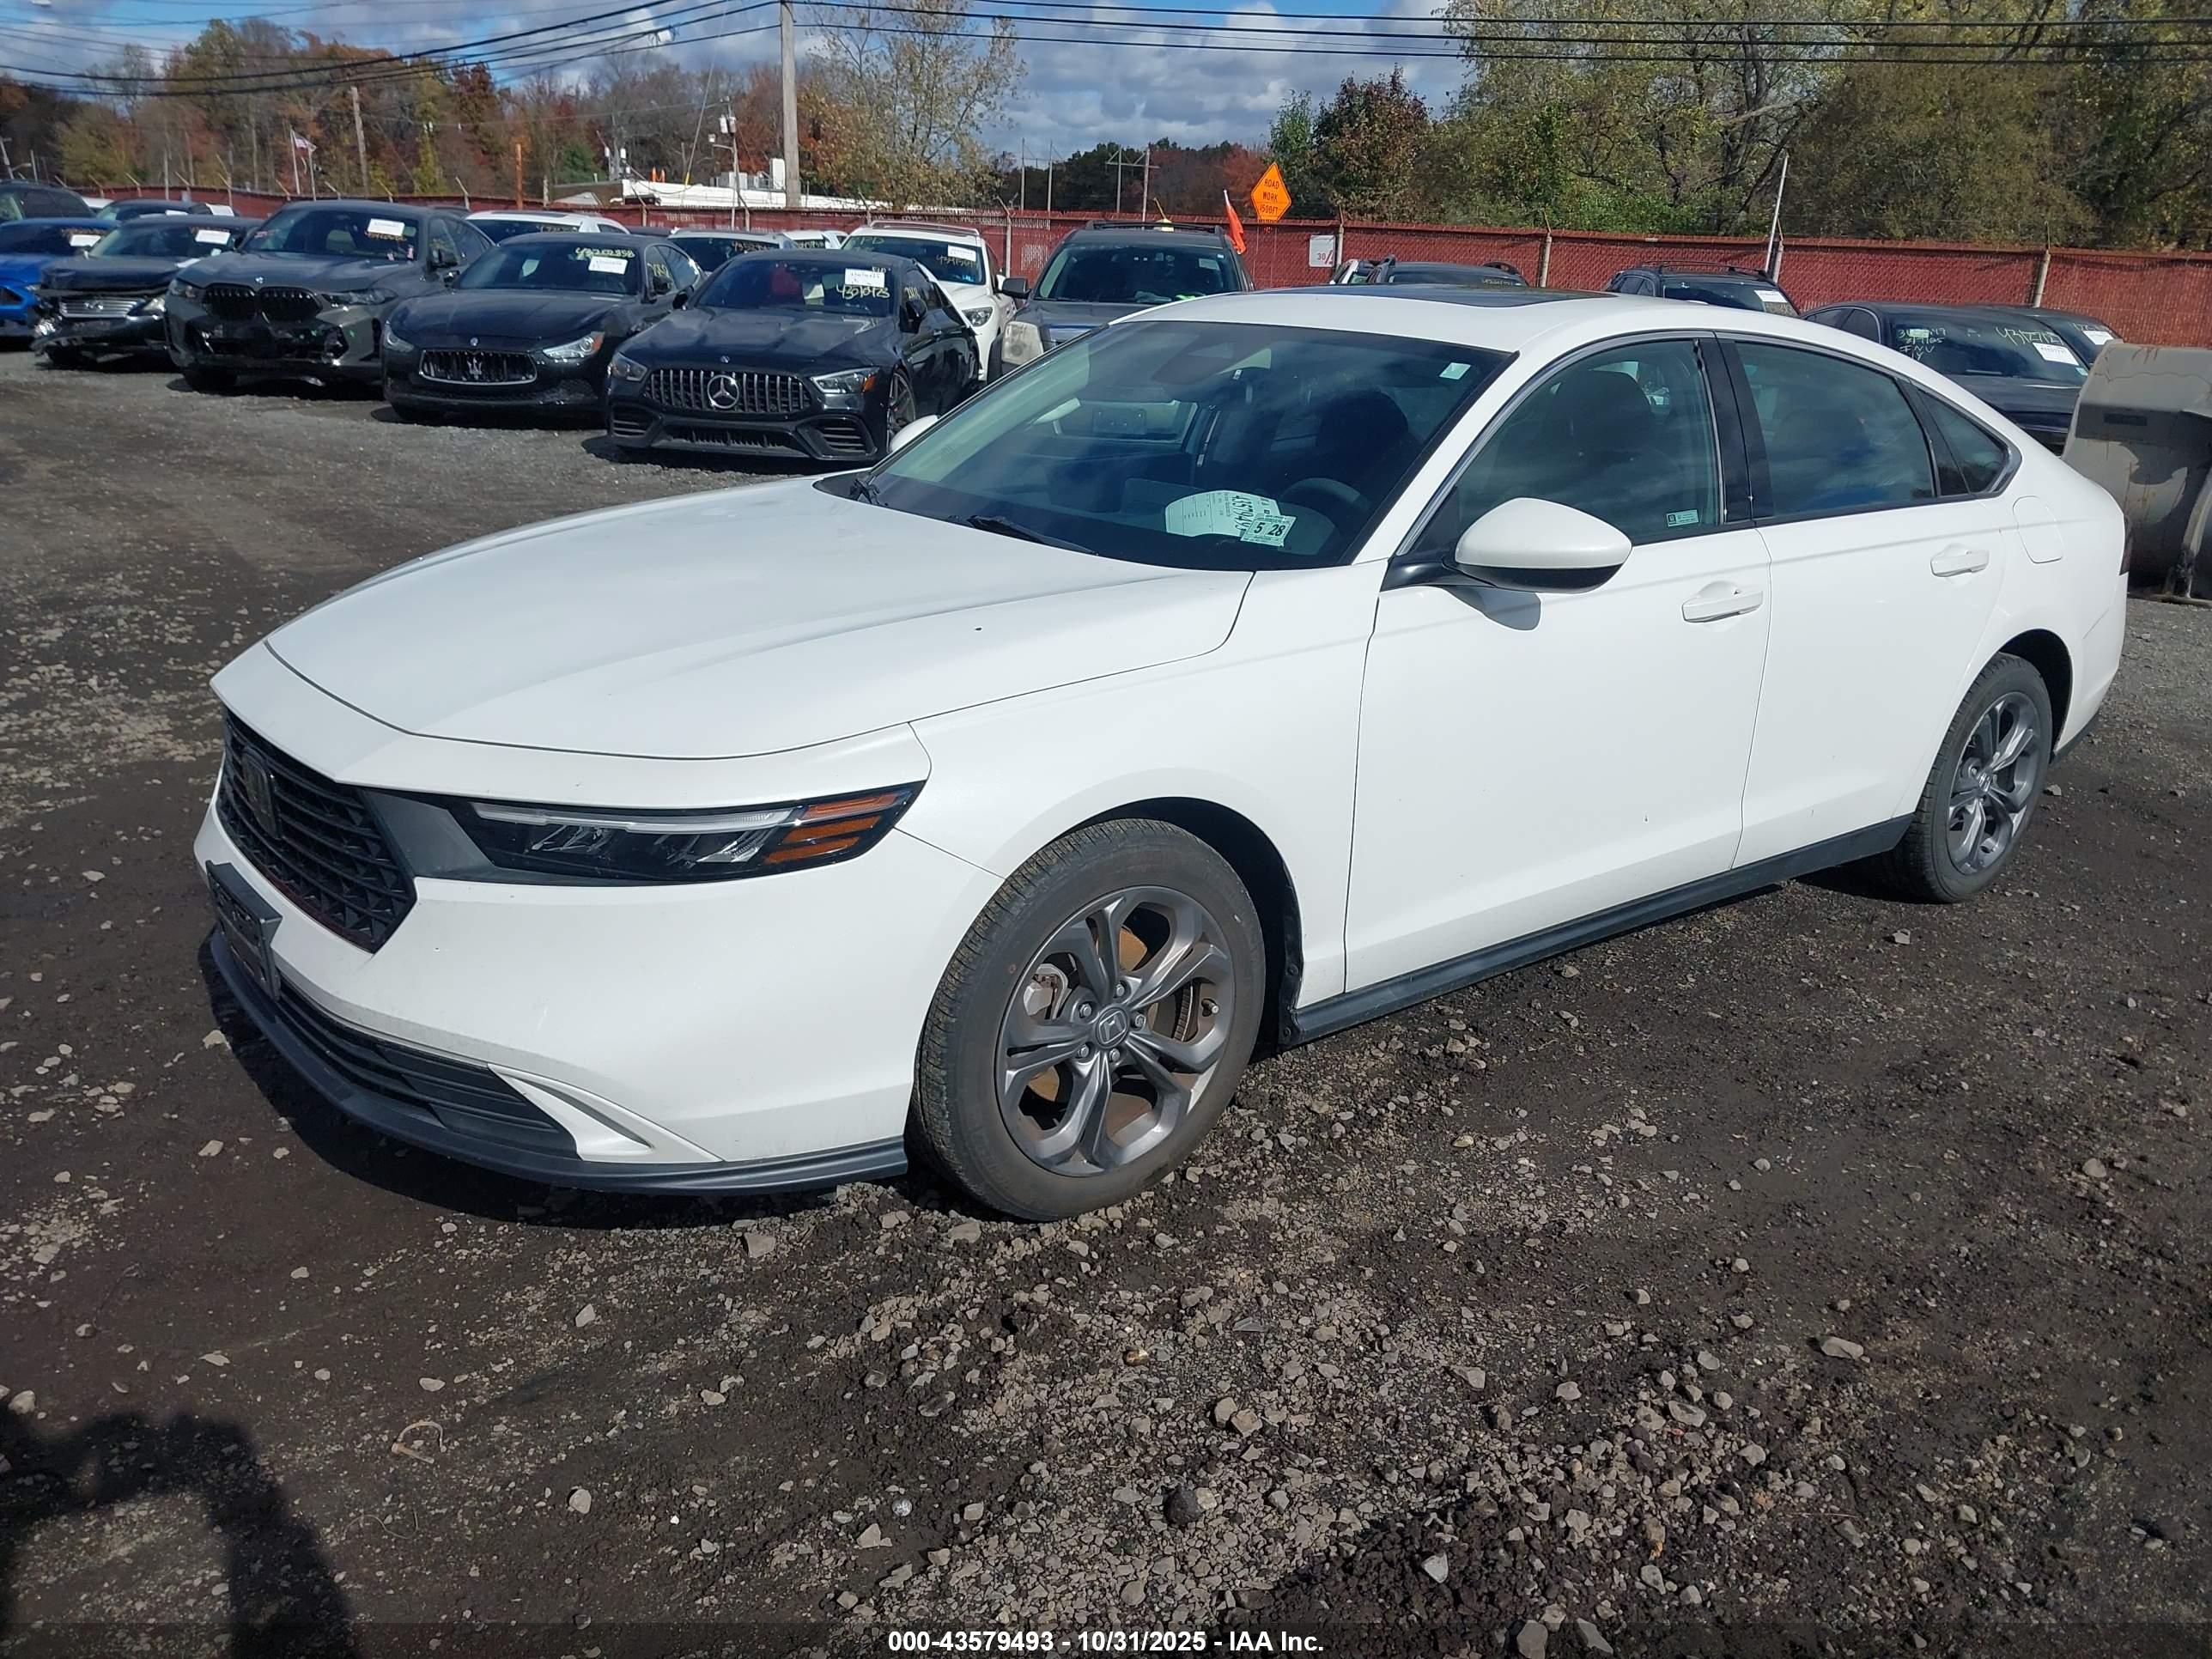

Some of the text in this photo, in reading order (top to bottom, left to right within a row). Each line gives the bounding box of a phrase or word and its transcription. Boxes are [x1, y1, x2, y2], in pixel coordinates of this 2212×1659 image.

[1264, 179, 1279, 190] ROAD
[1262, 191, 1278, 203] WORK
[1255, 522, 1286, 537] 5 28
